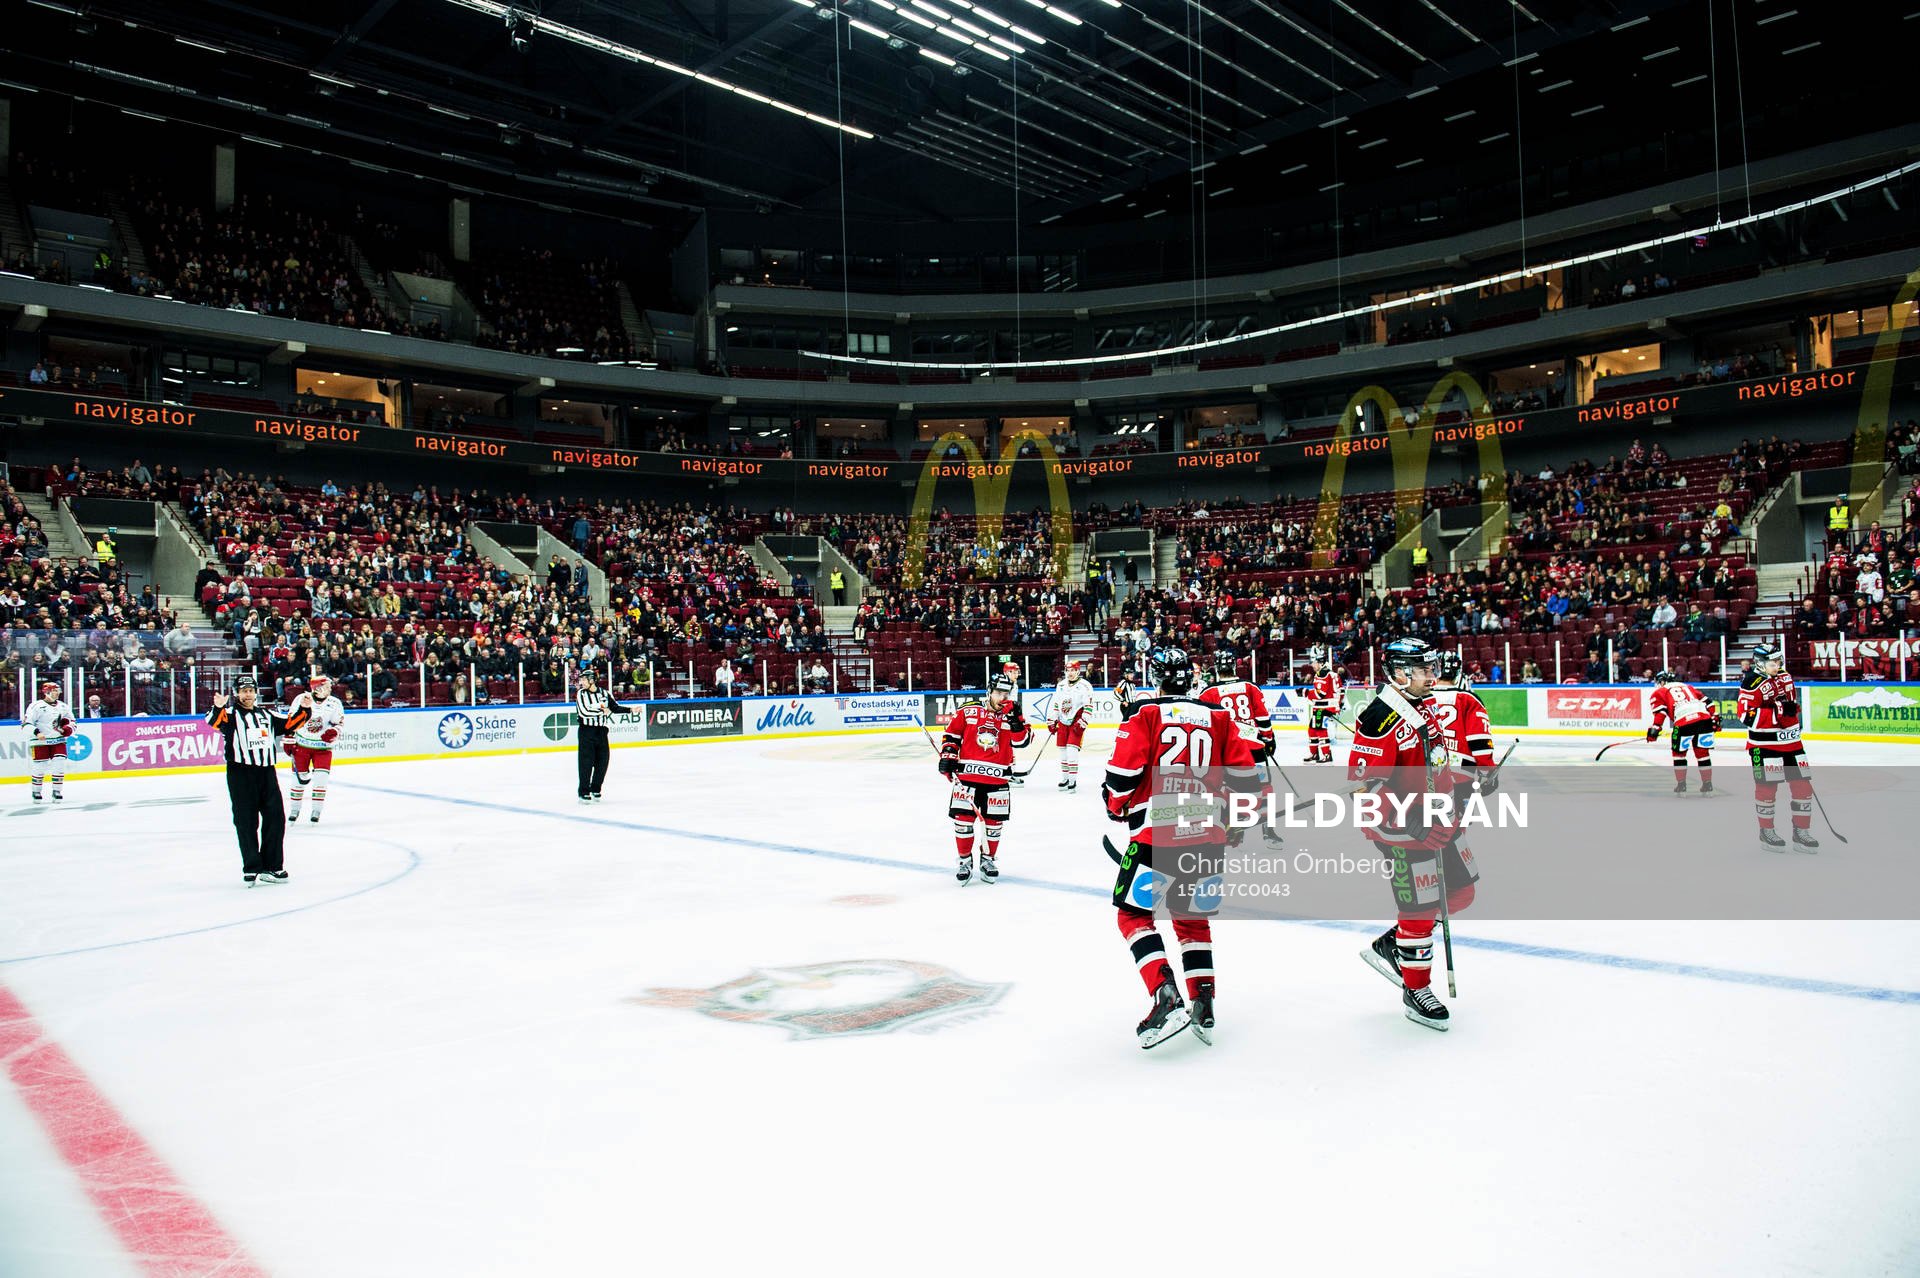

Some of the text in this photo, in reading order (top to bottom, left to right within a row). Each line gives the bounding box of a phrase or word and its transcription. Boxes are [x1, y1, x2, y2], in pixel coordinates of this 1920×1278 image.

[1738, 368, 1855, 400] navigator
[75, 402, 195, 426] navigator
[1578, 394, 1679, 423] navigator
[255, 420, 359, 442] navigator
[1435, 419, 1523, 440] navigator
[415, 436, 506, 457] navigator
[1304, 436, 1389, 457] navigator
[553, 449, 638, 467] navigator
[1178, 451, 1260, 468] navigator
[681, 459, 762, 475] navigator
[809, 465, 887, 478] navigator
[931, 463, 1010, 478] navigator
[1052, 459, 1132, 476] navigator
[851, 698, 920, 709] Örestadskyl AB
[1220, 694, 1251, 721] 88
[1556, 697, 1632, 711] CCM
[475, 714, 517, 730] Skåne
[619, 711, 641, 724] AB
[656, 707, 734, 725] OPTIMERA
[1559, 720, 1631, 729] MADE OF HOCKEY
[135, 723, 197, 736] SNACK BETTER
[368, 731, 397, 740] better
[475, 730, 517, 743] mejerier
[360, 741, 386, 750] world
[1159, 725, 1213, 778] 20
[965, 763, 1002, 778] areco
[1354, 757, 1367, 778] 3
[1752, 747, 1763, 779] akea
[1391, 845, 1413, 904] akea
